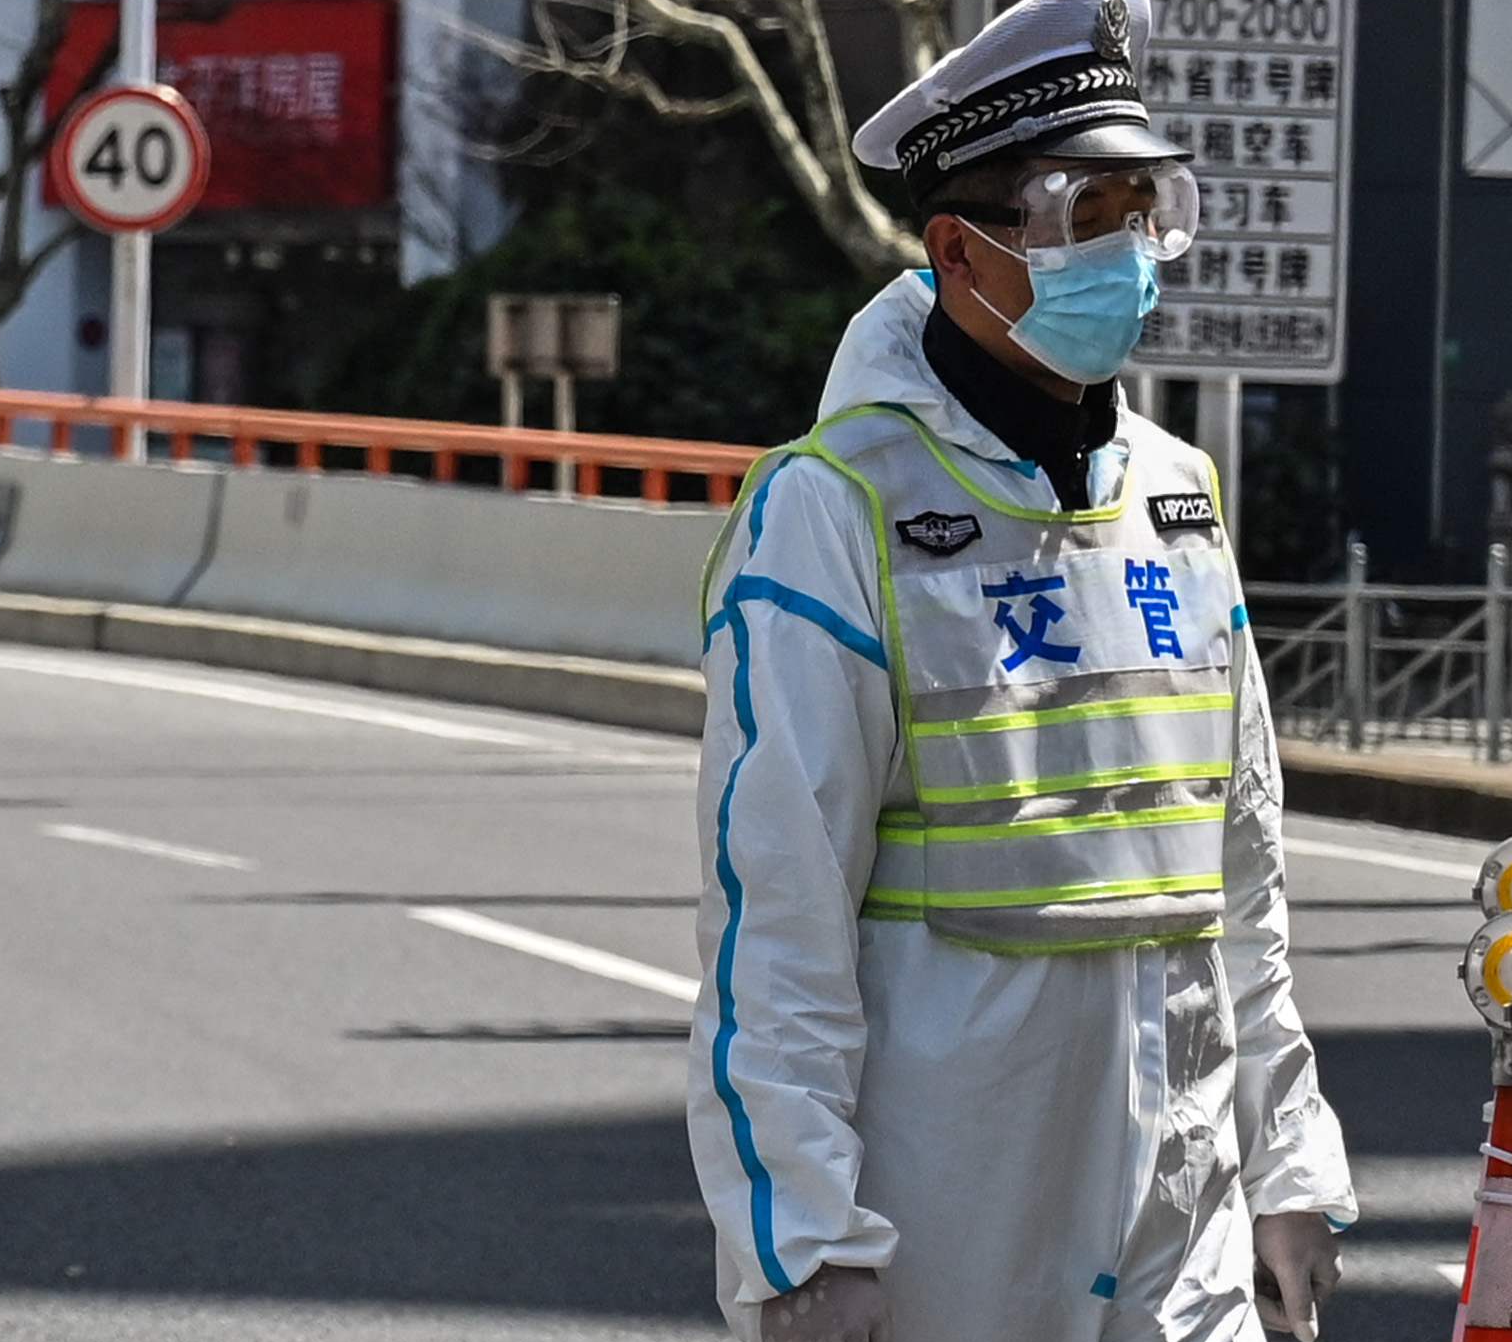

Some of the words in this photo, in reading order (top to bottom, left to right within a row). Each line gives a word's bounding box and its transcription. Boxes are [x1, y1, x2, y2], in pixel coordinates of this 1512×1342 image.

[85, 123, 173, 189] 40
[1156, 498, 1214, 523] HP2125
[981, 557, 1184, 674] 交管
